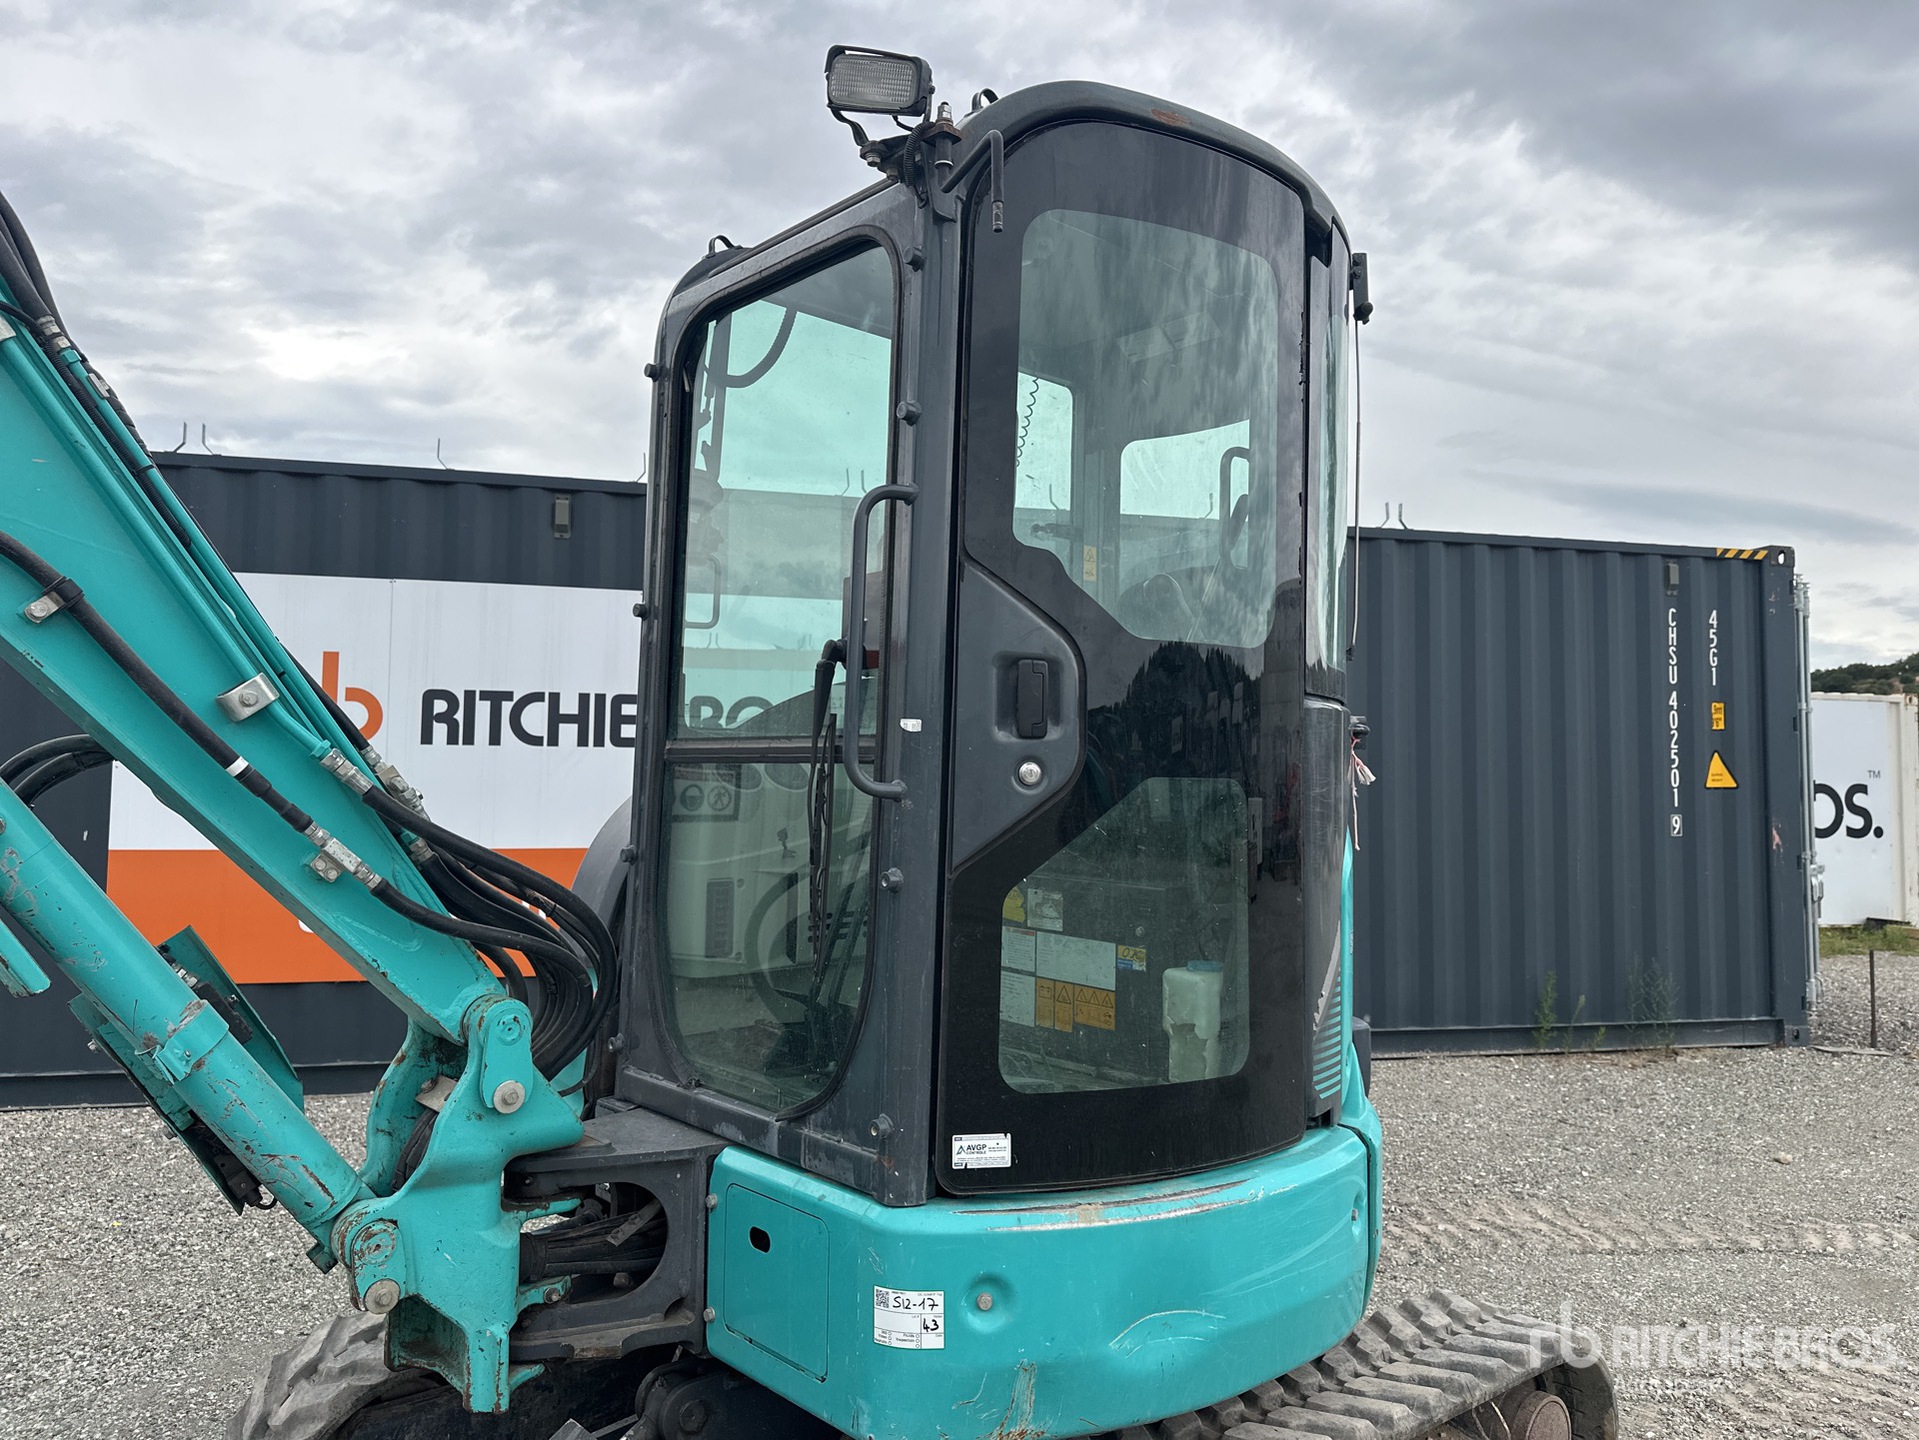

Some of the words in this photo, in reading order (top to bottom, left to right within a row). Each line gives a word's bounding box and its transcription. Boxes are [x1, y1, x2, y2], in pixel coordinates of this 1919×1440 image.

[1668, 608, 1678, 684] CHSU
[1708, 609, 1718, 686] 45G1
[420, 688, 638, 748] RITCHIE
[1672, 816, 1681, 835] 9
[1814, 782, 1884, 839] OS.
[922, 1318, 940, 1333] 43
